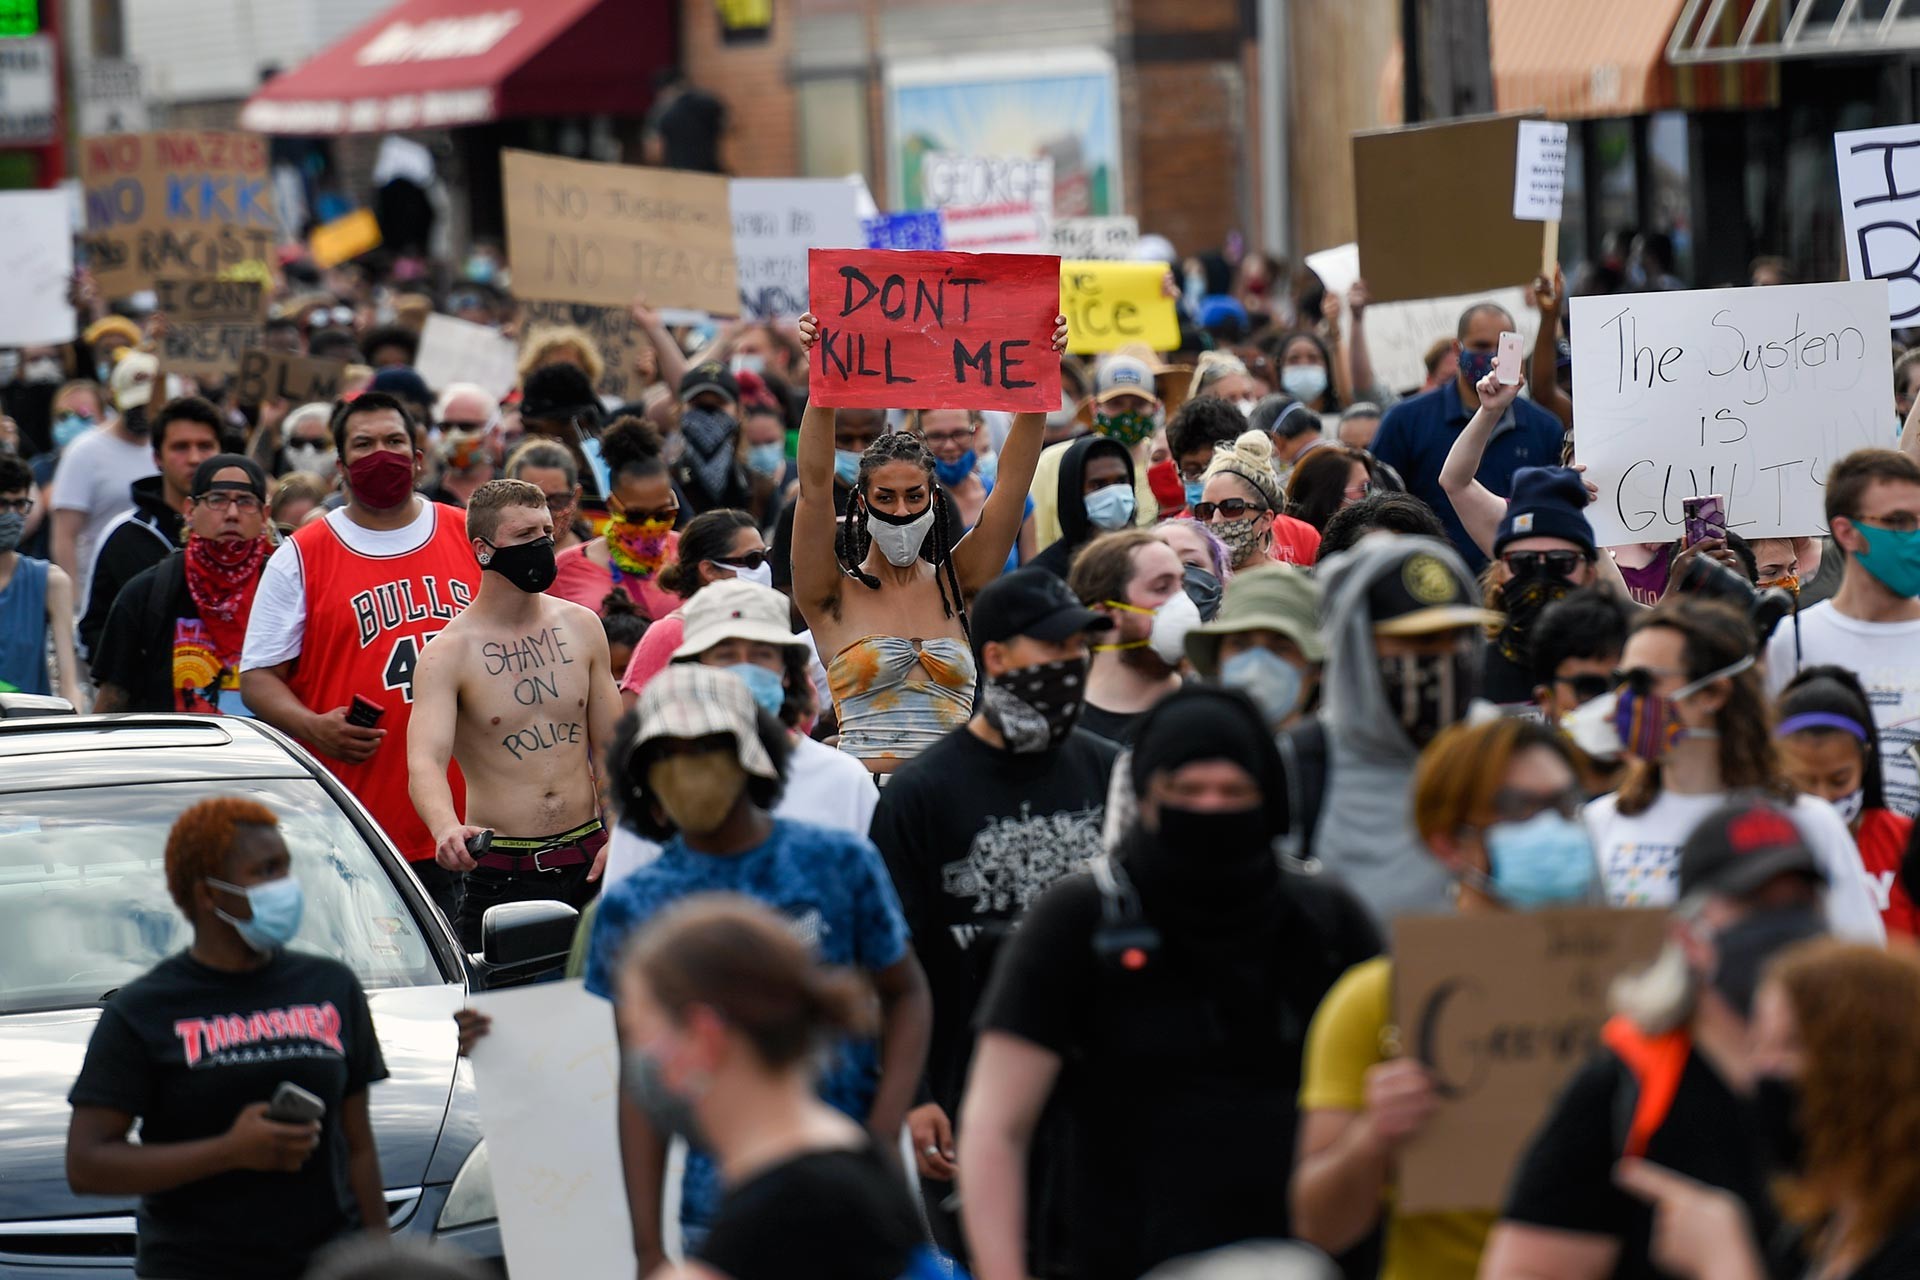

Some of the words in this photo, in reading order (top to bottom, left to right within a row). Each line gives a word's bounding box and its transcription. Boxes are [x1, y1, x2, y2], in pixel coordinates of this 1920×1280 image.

[88, 136, 142, 174] NO
[157, 132, 266, 171] NAZIS
[86, 178, 144, 230] NO
[166, 173, 274, 226] KKK
[530, 182, 588, 221] NO
[545, 233, 603, 288] NO
[839, 266, 986, 329] DON'T
[241, 351, 338, 402] BLM
[821, 327, 917, 384] KILL
[952, 339, 1037, 390] ME
[1600, 307, 1683, 393] The
[1707, 309, 1865, 405] System
[350, 575, 472, 649] BULLS
[382, 630, 442, 704] 4
[482, 627, 574, 676] SHAME
[514, 671, 559, 706] ON
[501, 722, 583, 761] POLICE
[174, 1000, 346, 1068] THRASHER
